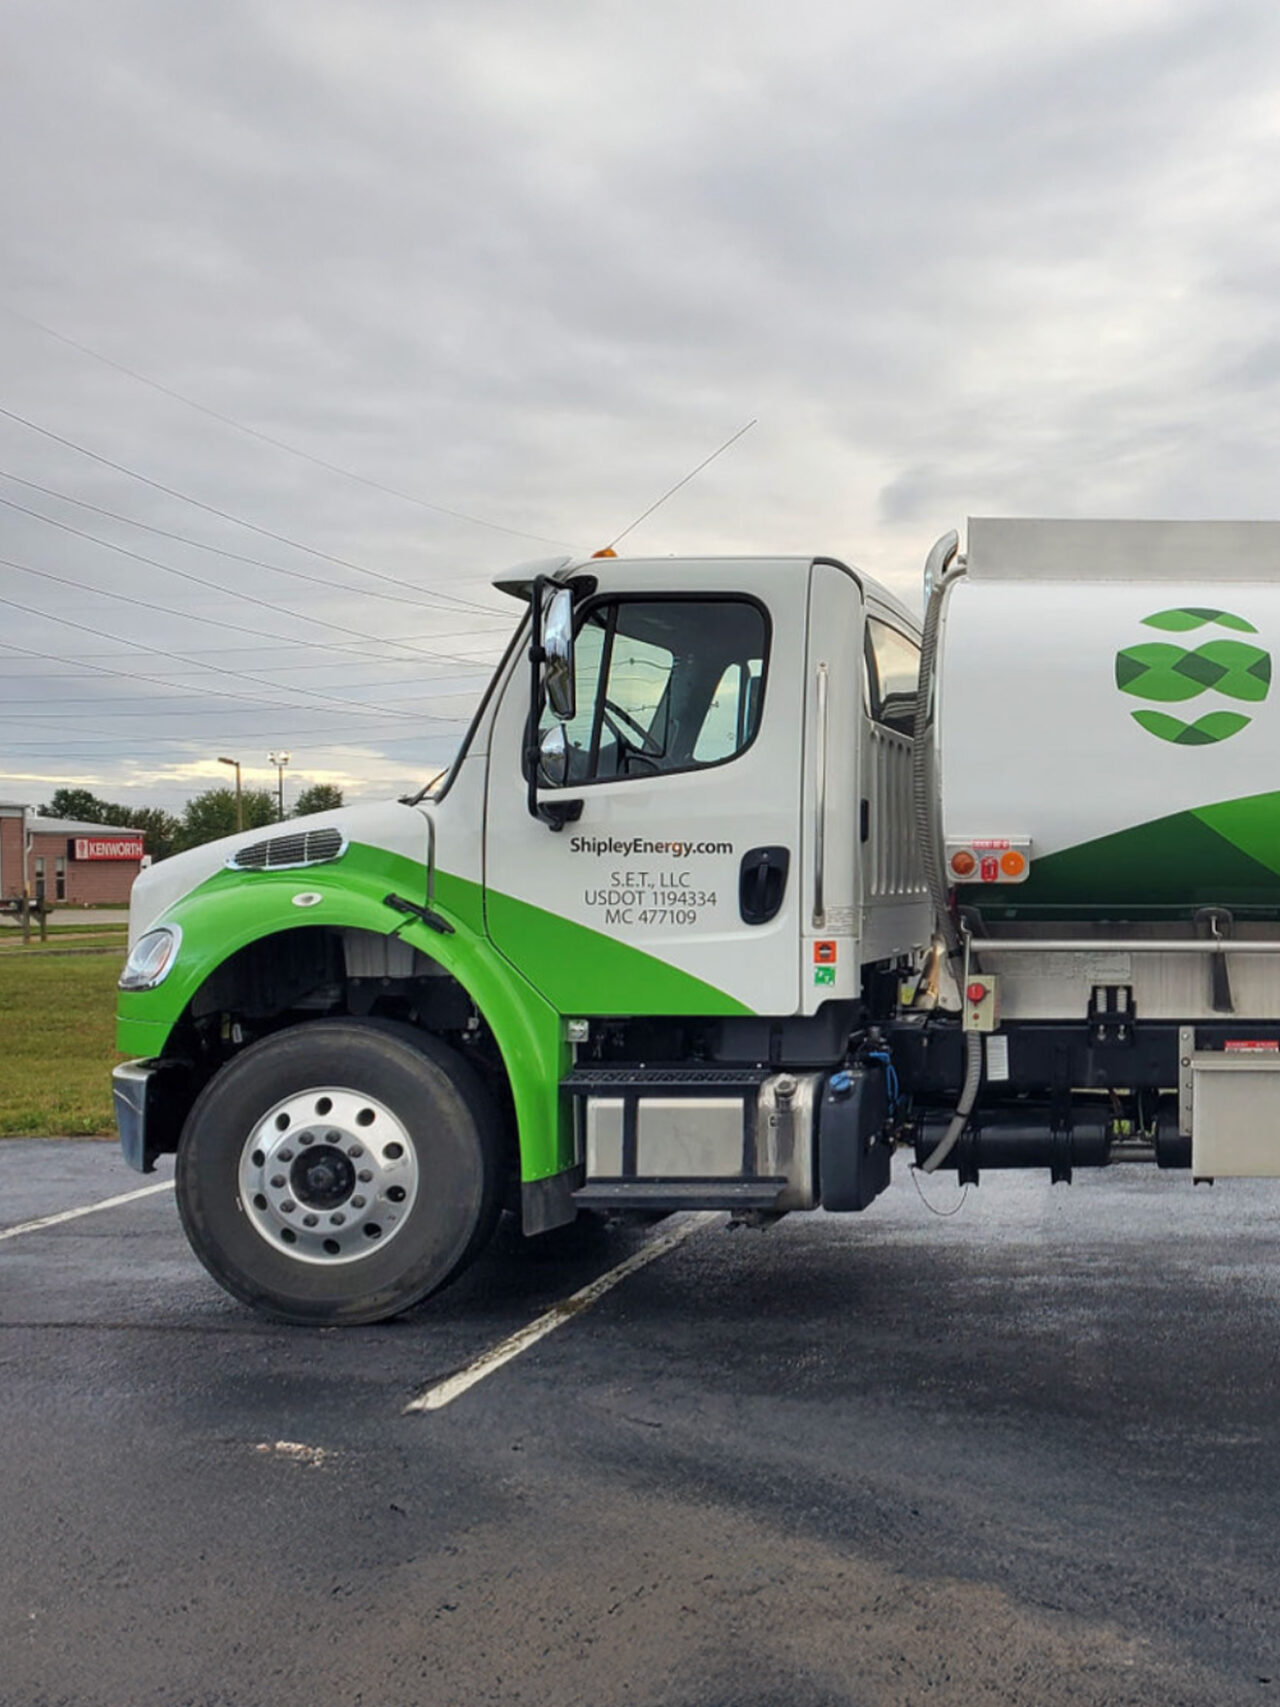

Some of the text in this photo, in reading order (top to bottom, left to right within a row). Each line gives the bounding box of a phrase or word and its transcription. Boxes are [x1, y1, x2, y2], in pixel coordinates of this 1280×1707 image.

[89, 842, 143, 856] KENWORTH
[570, 837, 733, 857] ShipleyEnergy.com
[610, 871, 690, 889] S.E.T., LLC
[584, 889, 717, 906] USDOT 1194334
[605, 909, 697, 924] MC 477109
